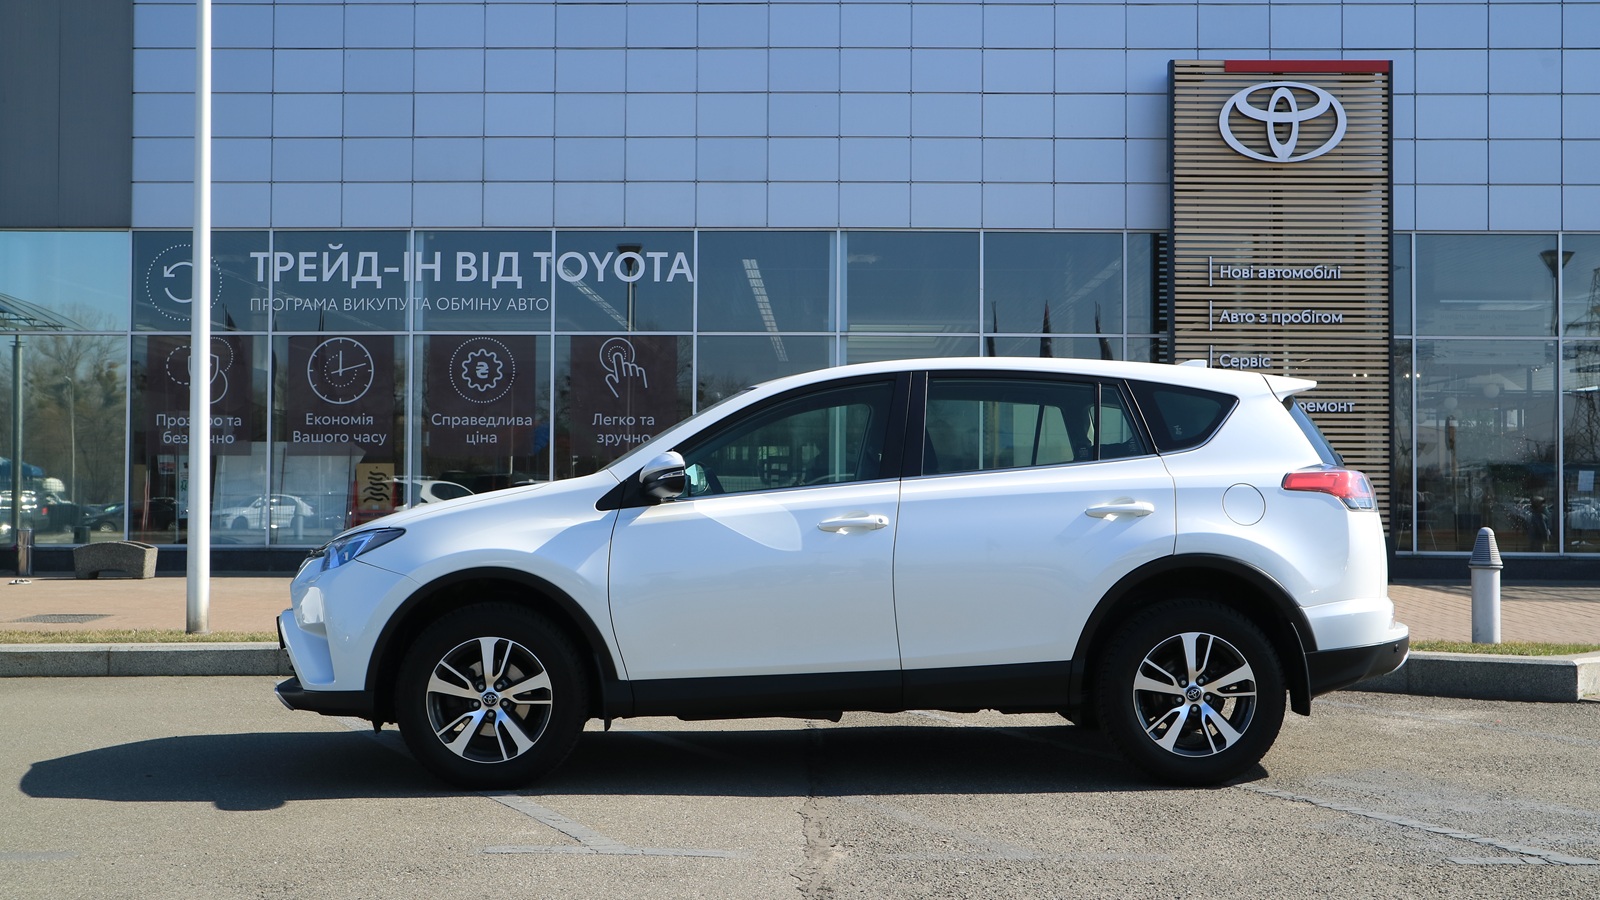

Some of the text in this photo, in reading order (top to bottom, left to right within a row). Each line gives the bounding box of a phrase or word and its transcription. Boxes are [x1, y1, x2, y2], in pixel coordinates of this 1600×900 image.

[250, 244, 694, 289] ТРЕЙД-ІН ВІД TOYOTA
[1220, 265, 1341, 279] Нові автомобілі
[250, 297, 549, 311] ПРОГРАМА ВИКУПУ ТА ОБМІНУ АВТО
[1220, 309, 1343, 327] Авто з пробігом
[1219, 353, 1271, 370] Сервіс
[156, 413, 242, 429] Проо та
[305, 413, 373, 425] Економія
[431, 413, 533, 428] Справедлива
[592, 413, 655, 426] Легко та
[293, 430, 387, 446] Вашого часу
[466, 430, 497, 445] ціна
[597, 433, 651, 446] зручно
